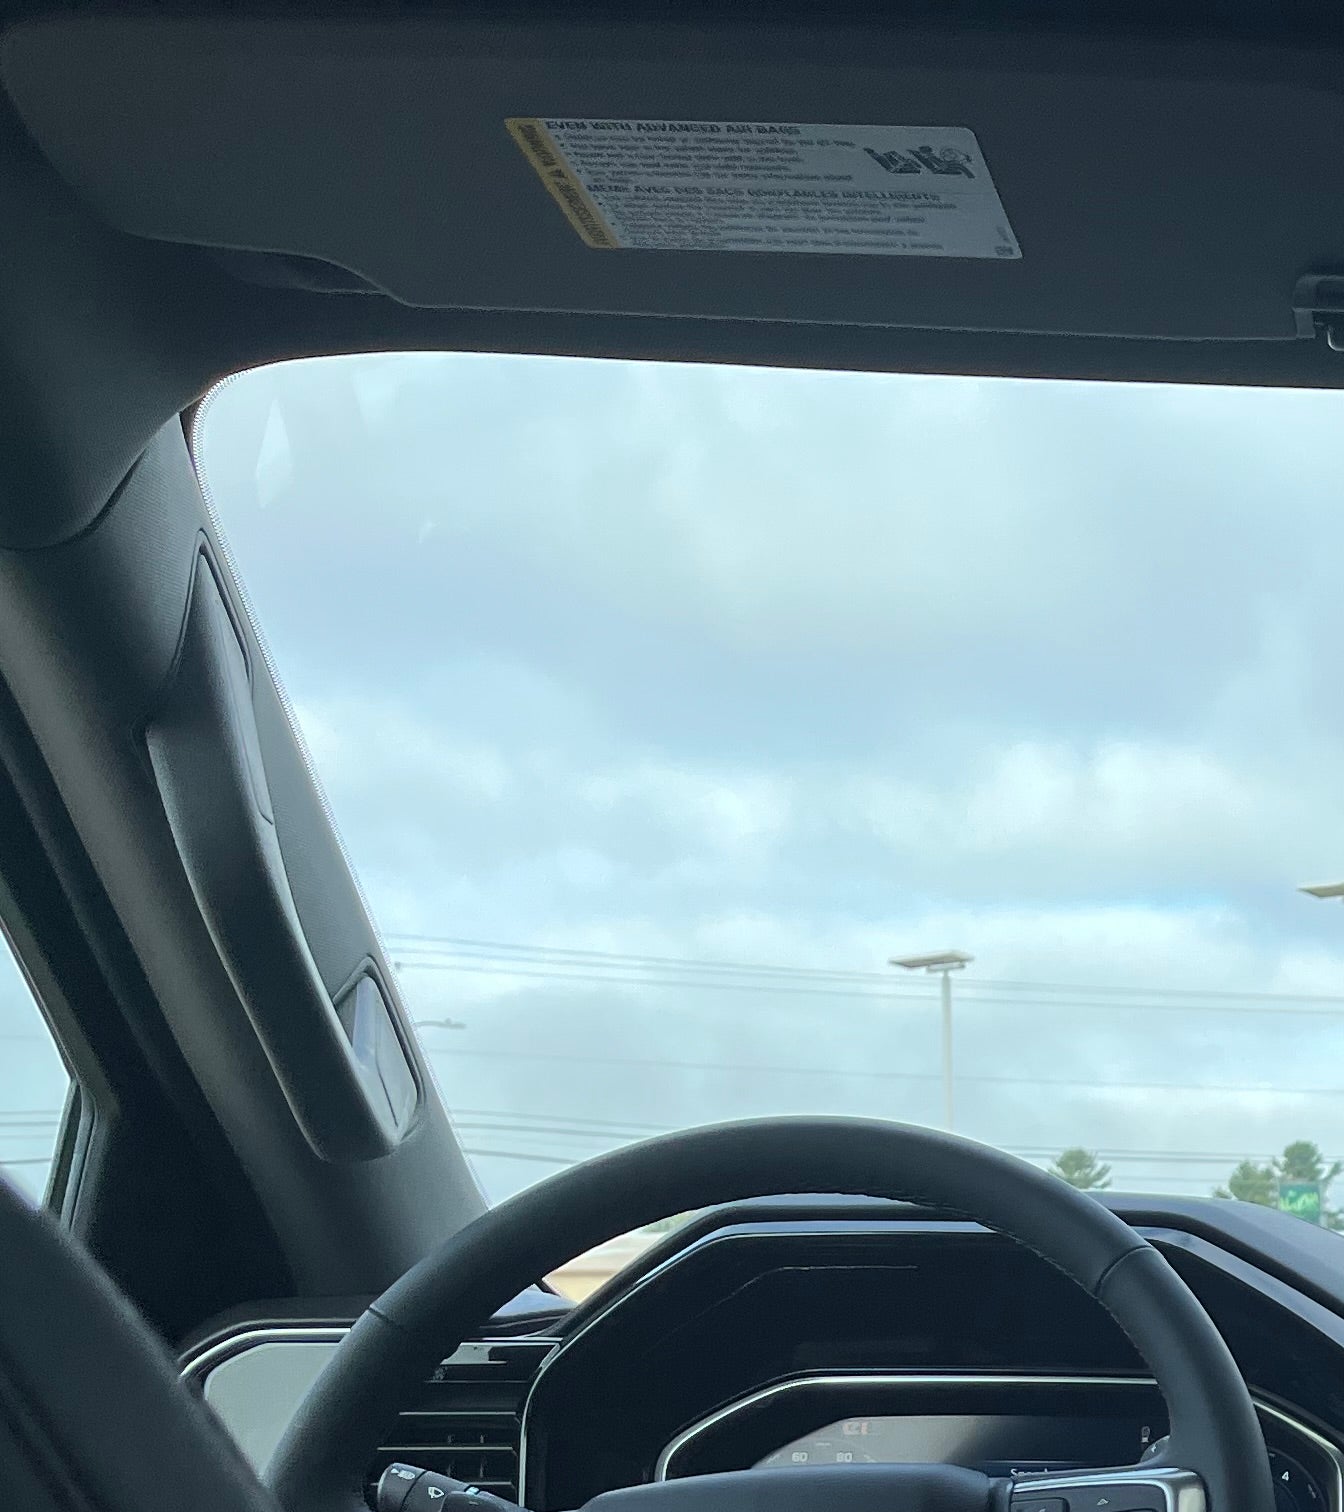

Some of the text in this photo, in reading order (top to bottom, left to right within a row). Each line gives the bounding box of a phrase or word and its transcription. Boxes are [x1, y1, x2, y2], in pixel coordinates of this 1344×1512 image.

[791, 1452, 808, 1462] 60
[836, 1452, 853, 1462] 80
[1281, 1471, 1290, 1481] 4
